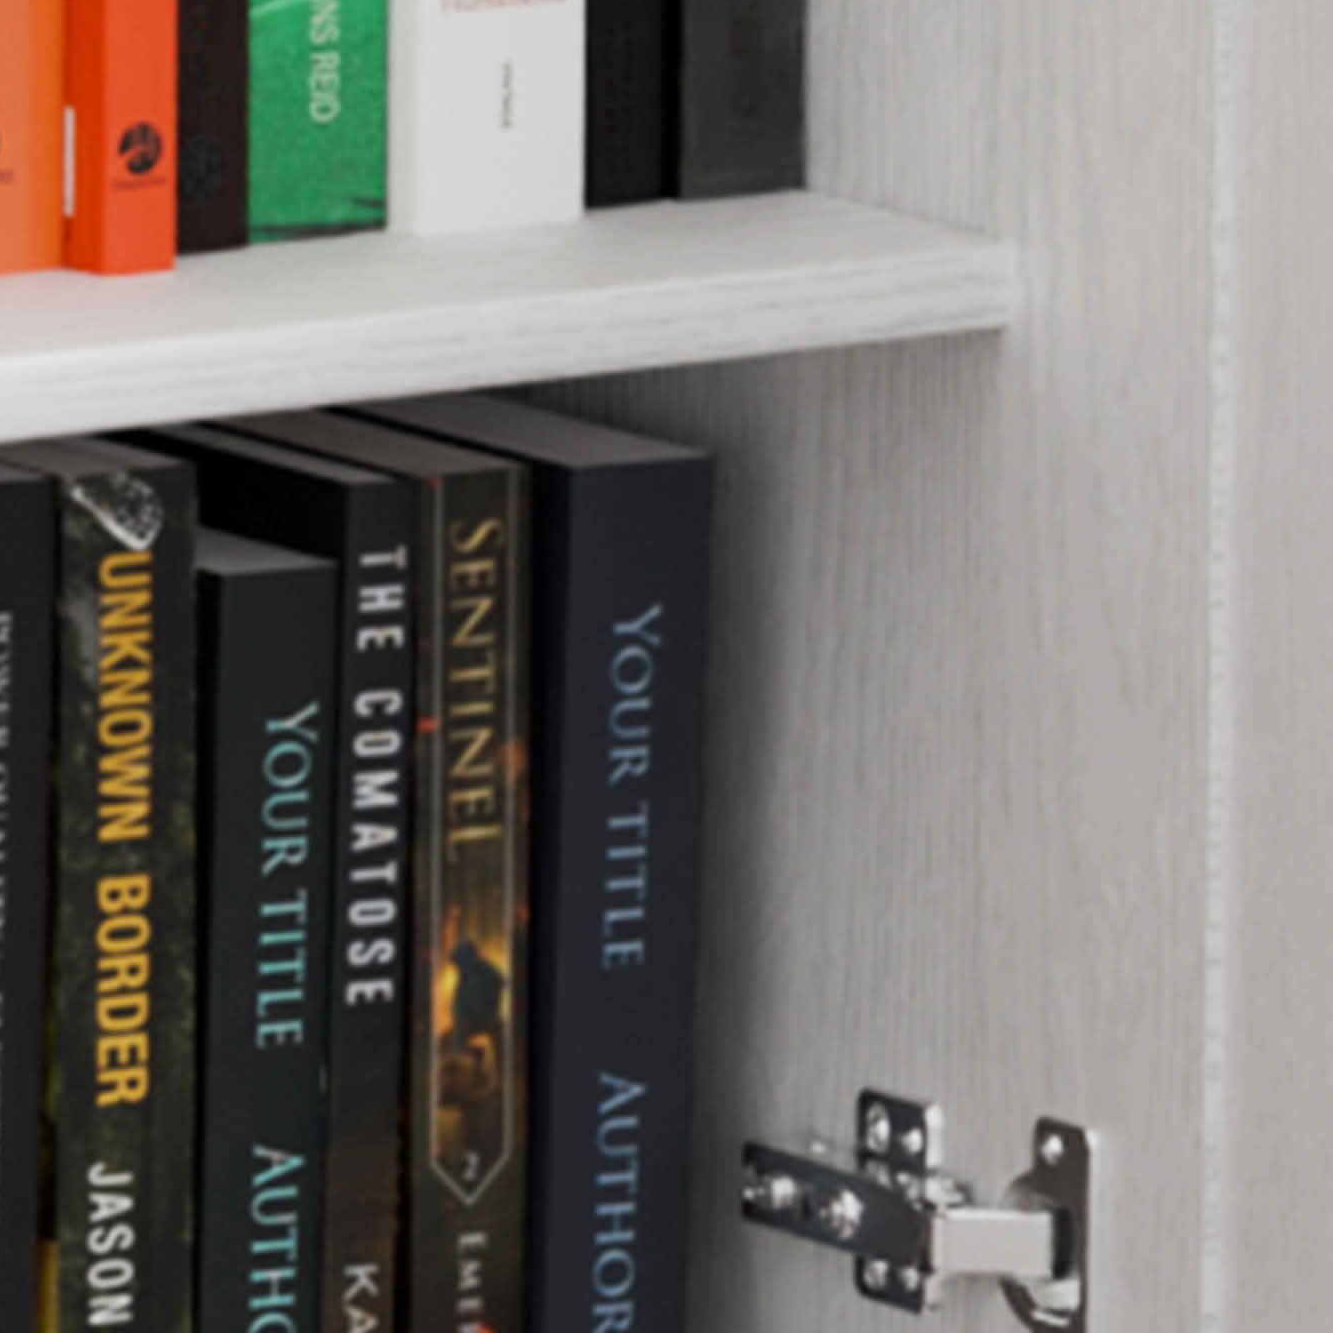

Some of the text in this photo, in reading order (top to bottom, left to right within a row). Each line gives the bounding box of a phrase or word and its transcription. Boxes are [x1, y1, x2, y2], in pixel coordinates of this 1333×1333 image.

[309, 50, 341, 123] REID
[356, 545, 407, 651] THE
[446, 517, 503, 864] SENTINEL
[261, 701, 321, 876] YOUR
[345, 688, 406, 1005] COMATOSE
[86, 552, 153, 1327] UNKNOWN BORDER JASON
[255, 889, 309, 1047] TITLE
[590, 603, 664, 1333] YOUR TITLE AUTHOR
